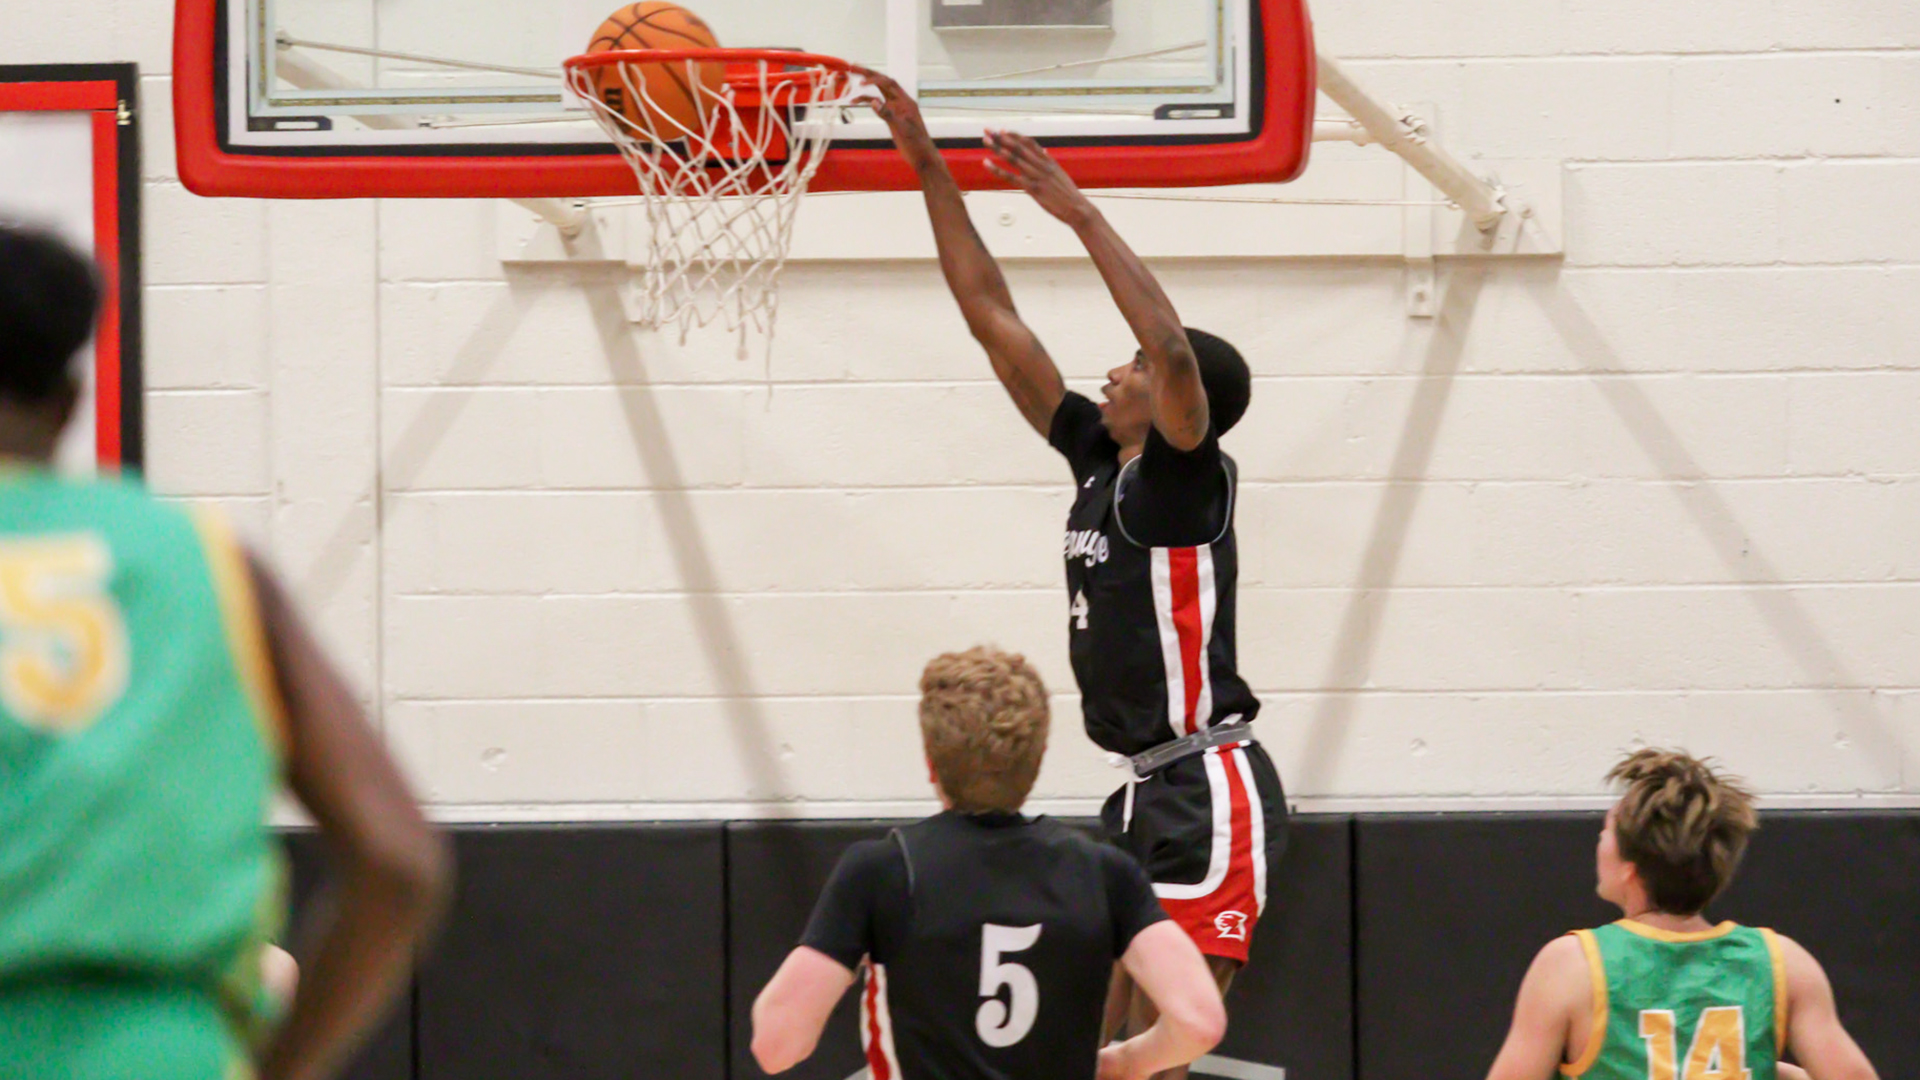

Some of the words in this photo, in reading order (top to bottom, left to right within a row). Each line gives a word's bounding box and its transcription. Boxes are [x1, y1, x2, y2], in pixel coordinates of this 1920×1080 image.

[0, 531, 132, 733] 5
[1070, 590, 1089, 630] 4
[975, 922, 1043, 1048] 5
[1638, 1005, 1753, 1080] 14
